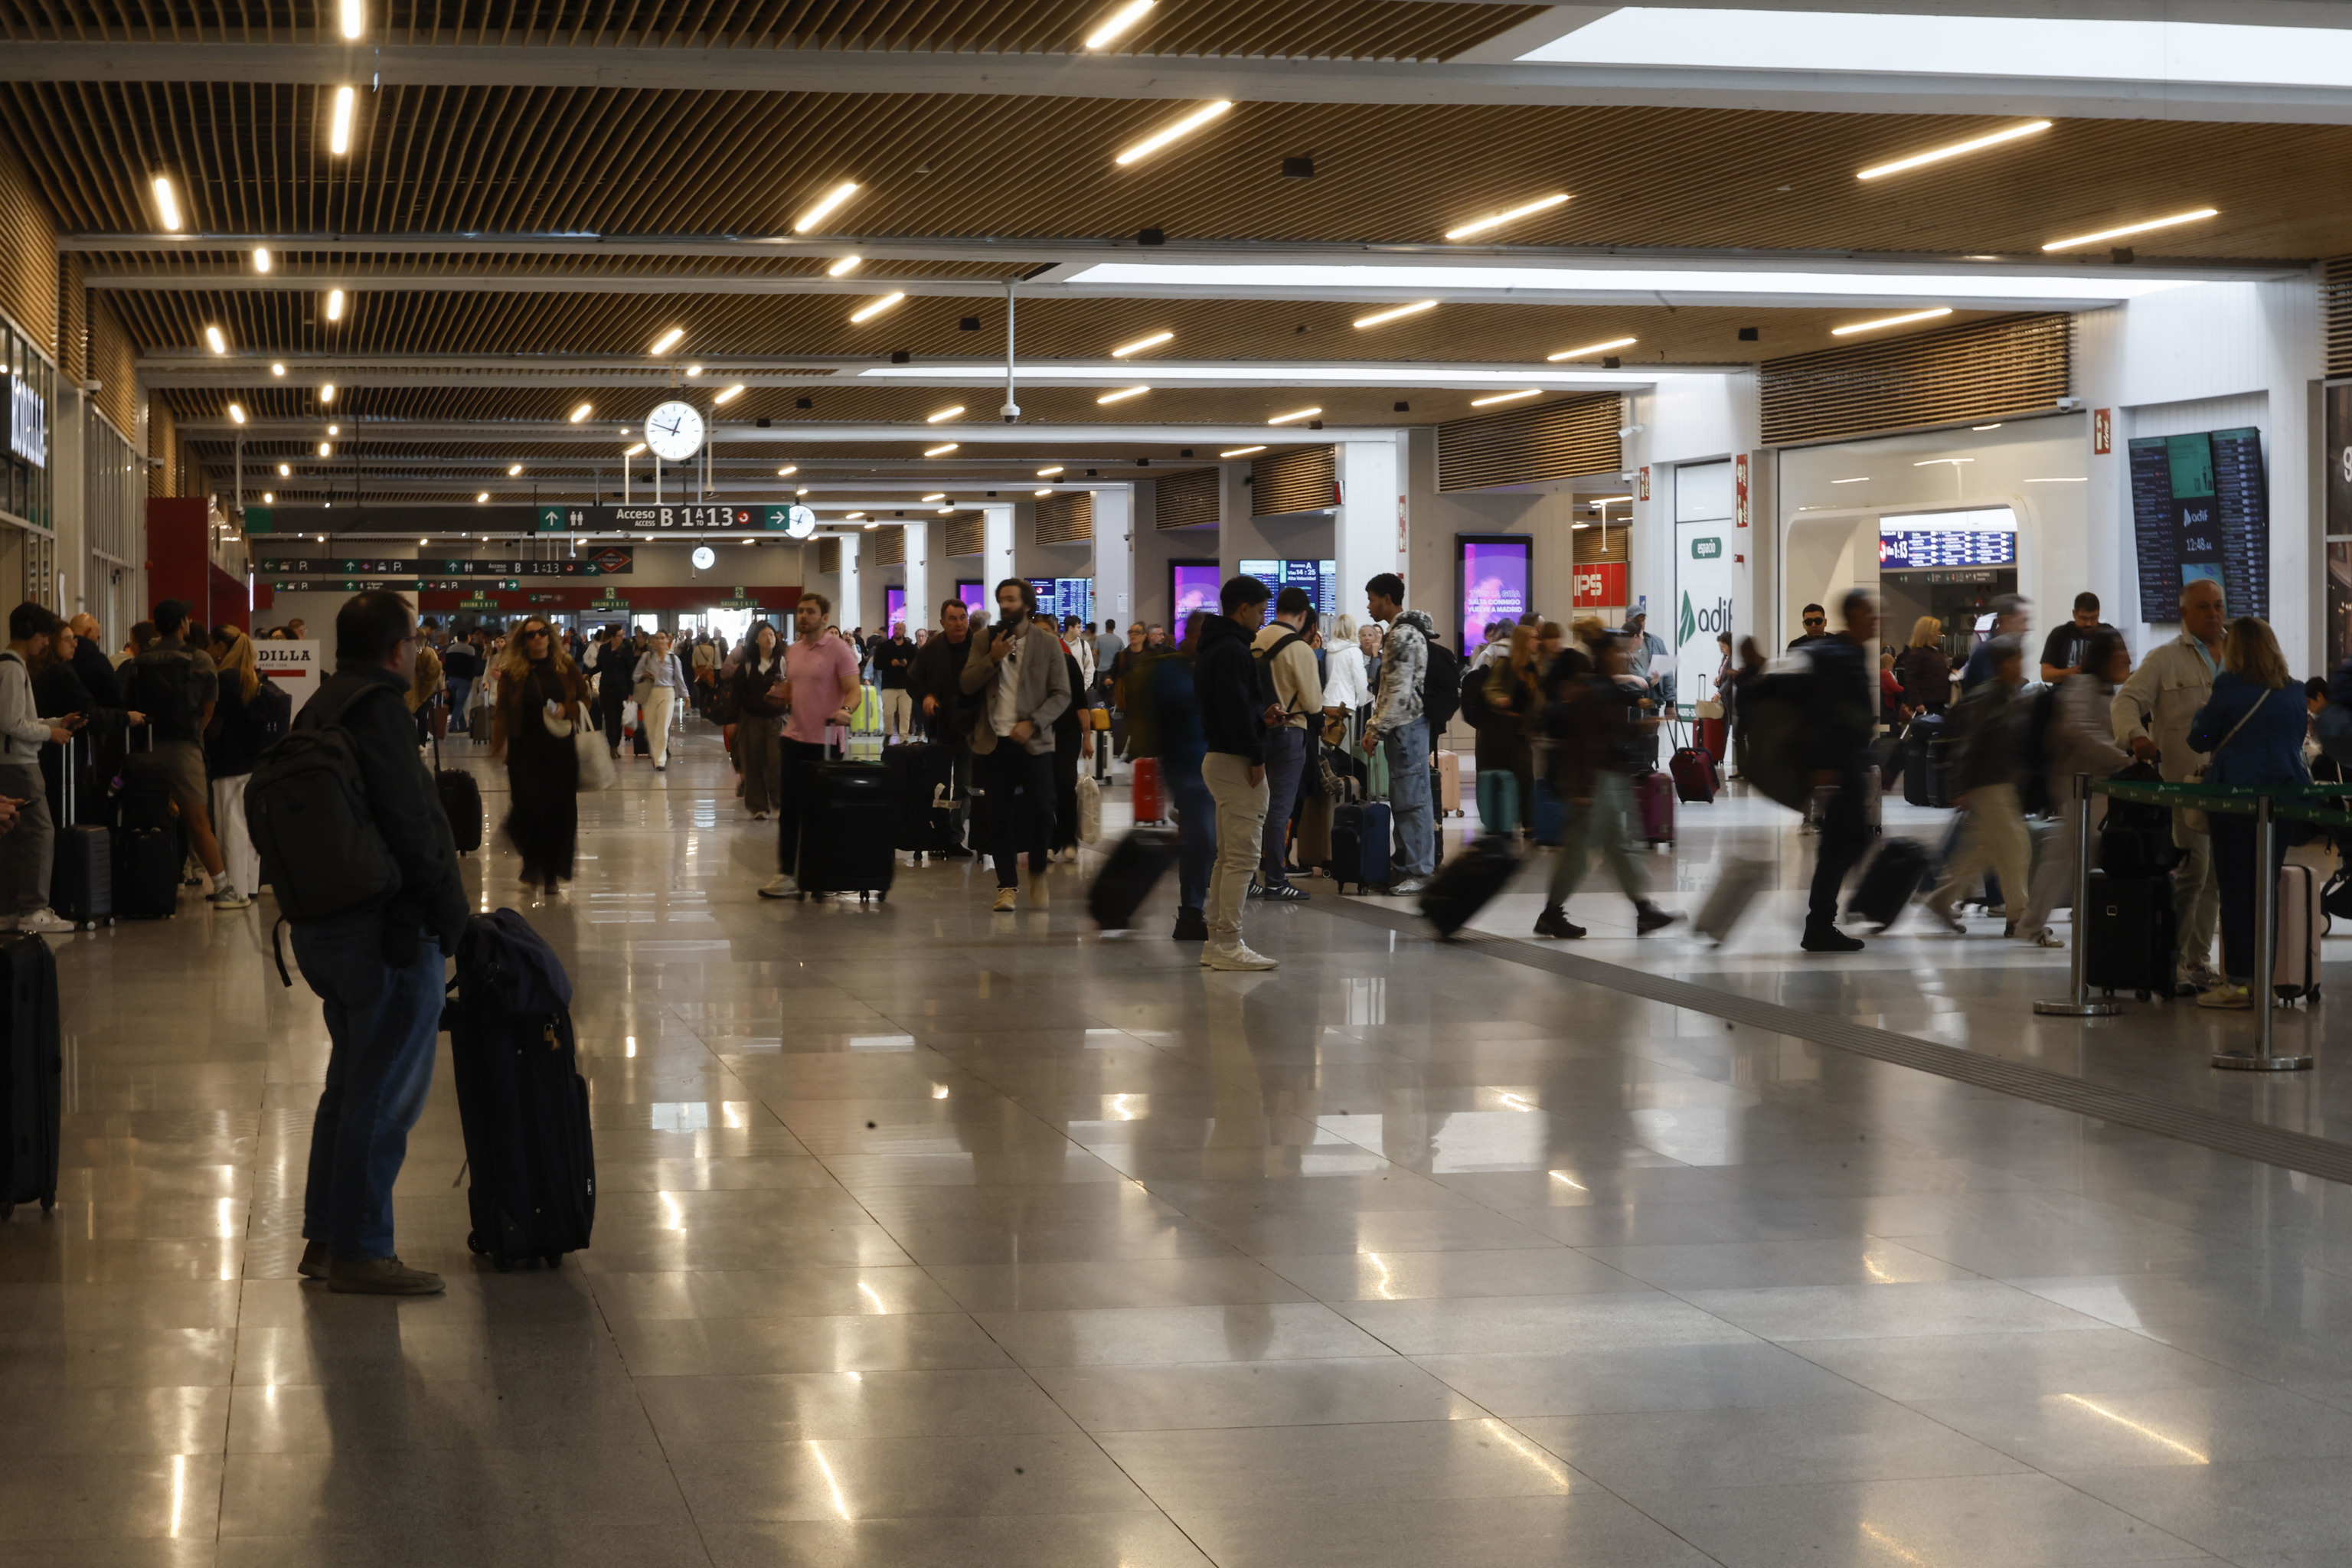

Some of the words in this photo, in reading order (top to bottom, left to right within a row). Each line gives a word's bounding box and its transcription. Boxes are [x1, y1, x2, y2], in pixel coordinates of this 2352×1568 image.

[616, 508, 655, 519] Acceso
[660, 508, 674, 527] B
[681, 508, 694, 527] 1
[695, 508, 704, 518] A
[707, 508, 733, 527] 13
[1697, 538, 1716, 557] espacio
[514, 562, 521, 573] B
[1573, 573, 1602, 596] IPS
[259, 650, 312, 661] DILLA
